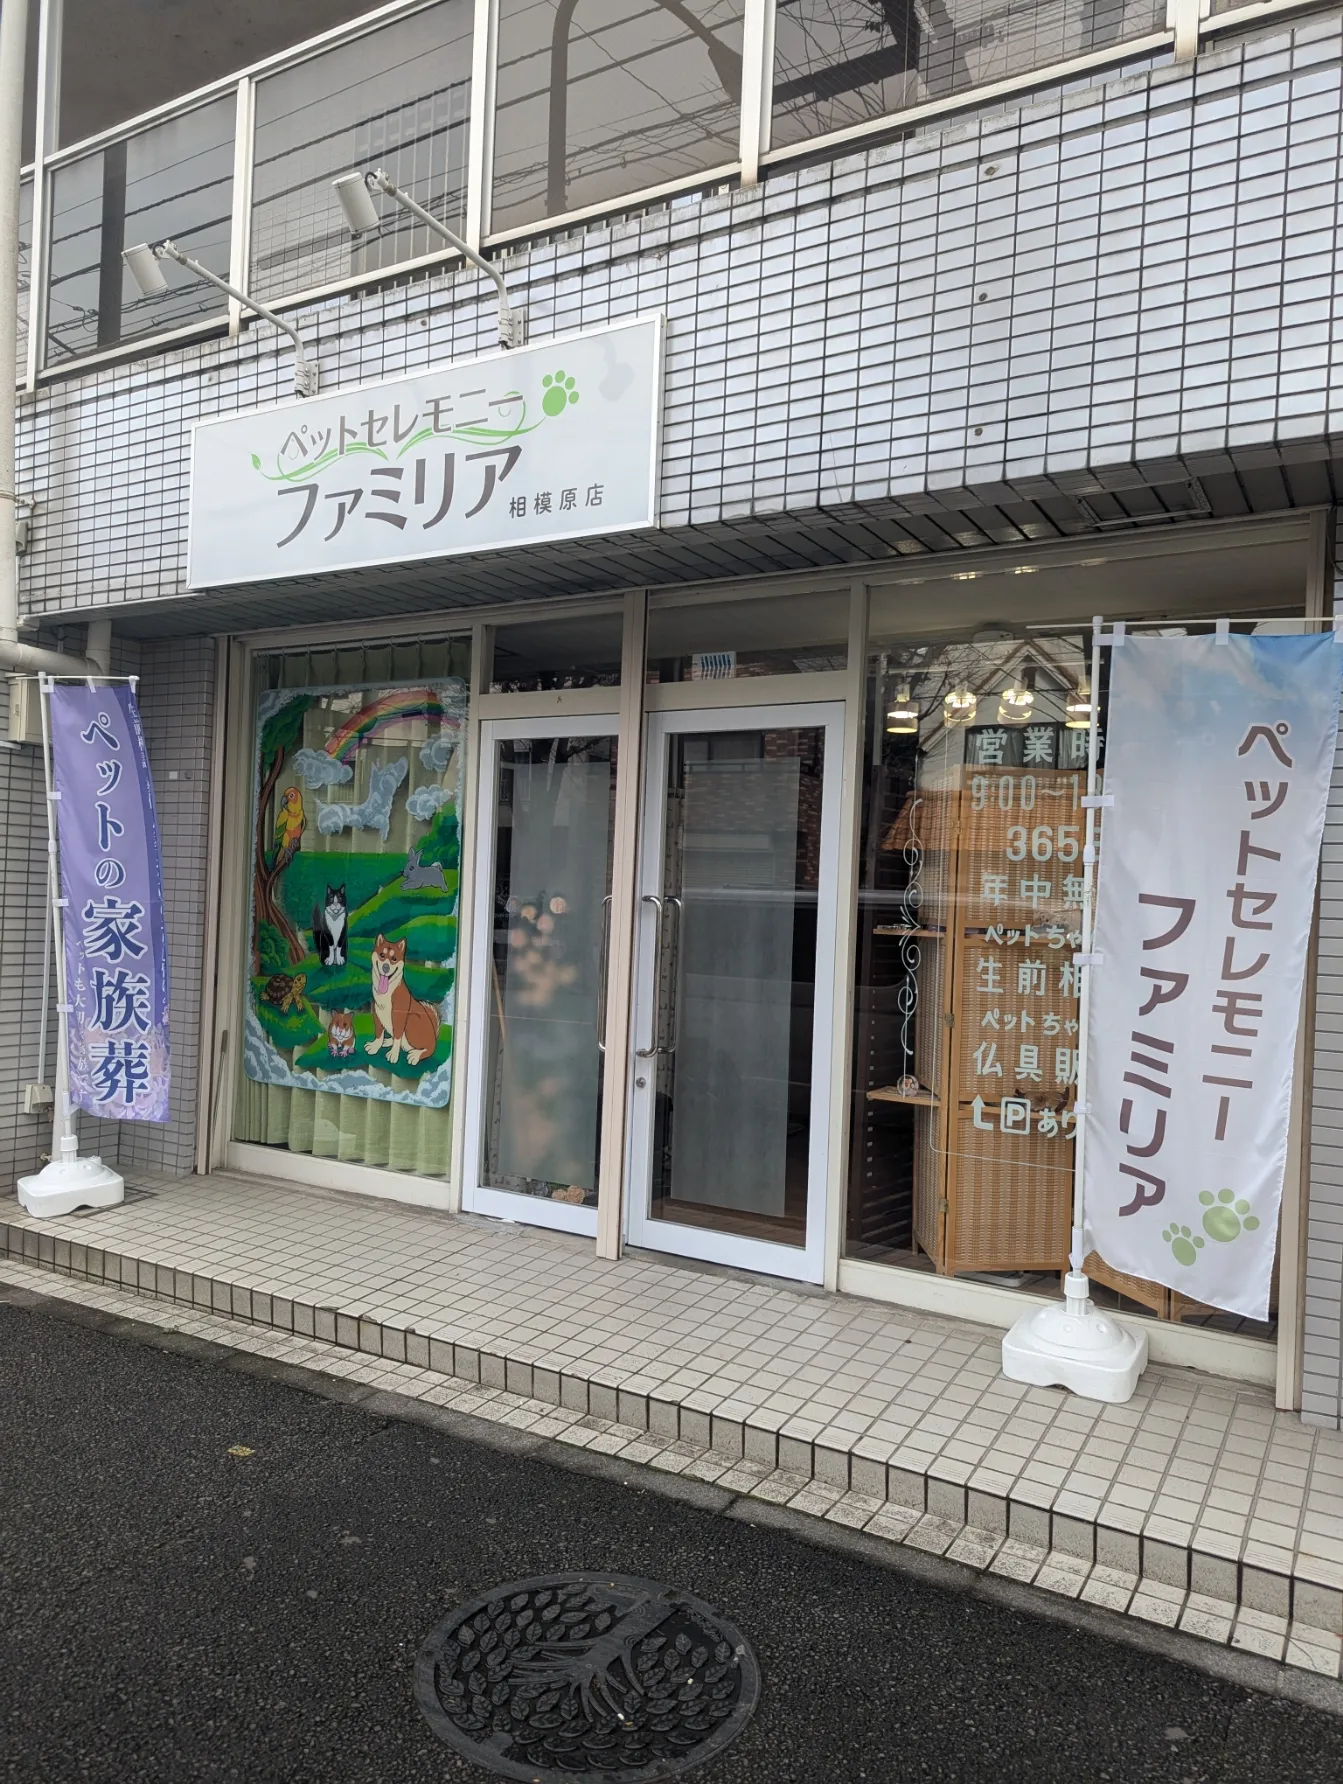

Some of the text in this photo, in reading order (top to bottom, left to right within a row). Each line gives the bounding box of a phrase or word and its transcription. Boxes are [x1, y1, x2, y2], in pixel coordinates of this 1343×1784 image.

[279, 388, 525, 460] ペットセレモニー
[276, 445, 523, 549] ファミリア
[508, 483, 605, 520] 相模原店
[971, 774, 1103, 811] 9:00～1
[1006, 825, 1101, 862] 365
[80, 711, 151, 1106] ペットの家族葬
[1202, 722, 1293, 1141] ペットセレモニー
[1118, 892, 1197, 1217] ファミリア
